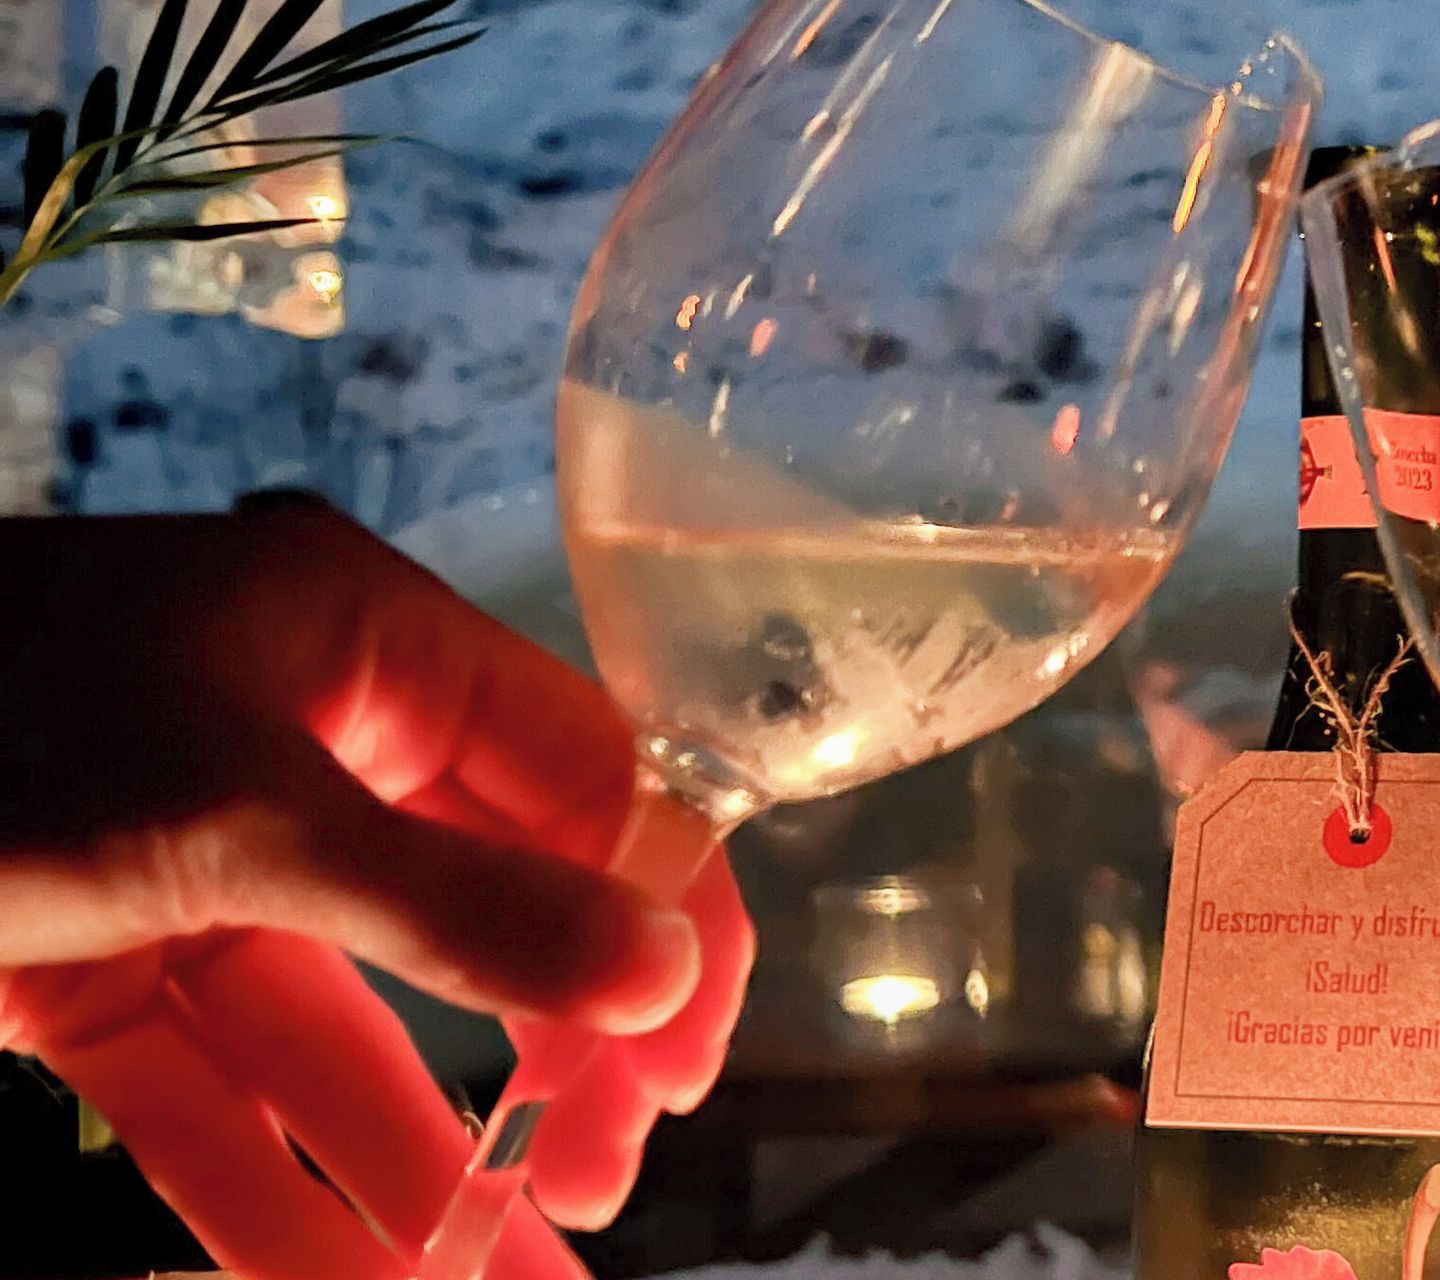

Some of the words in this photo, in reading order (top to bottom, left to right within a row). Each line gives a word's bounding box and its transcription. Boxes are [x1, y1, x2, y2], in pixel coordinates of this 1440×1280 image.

[1199, 900, 1343, 936] Descorchar
[1352, 914, 1364, 941] y
[1305, 960, 1388, 995] ¡Salud!
[1226, 1010, 1328, 1046] ¡Gracias
[1336, 1024, 1380, 1052] por
